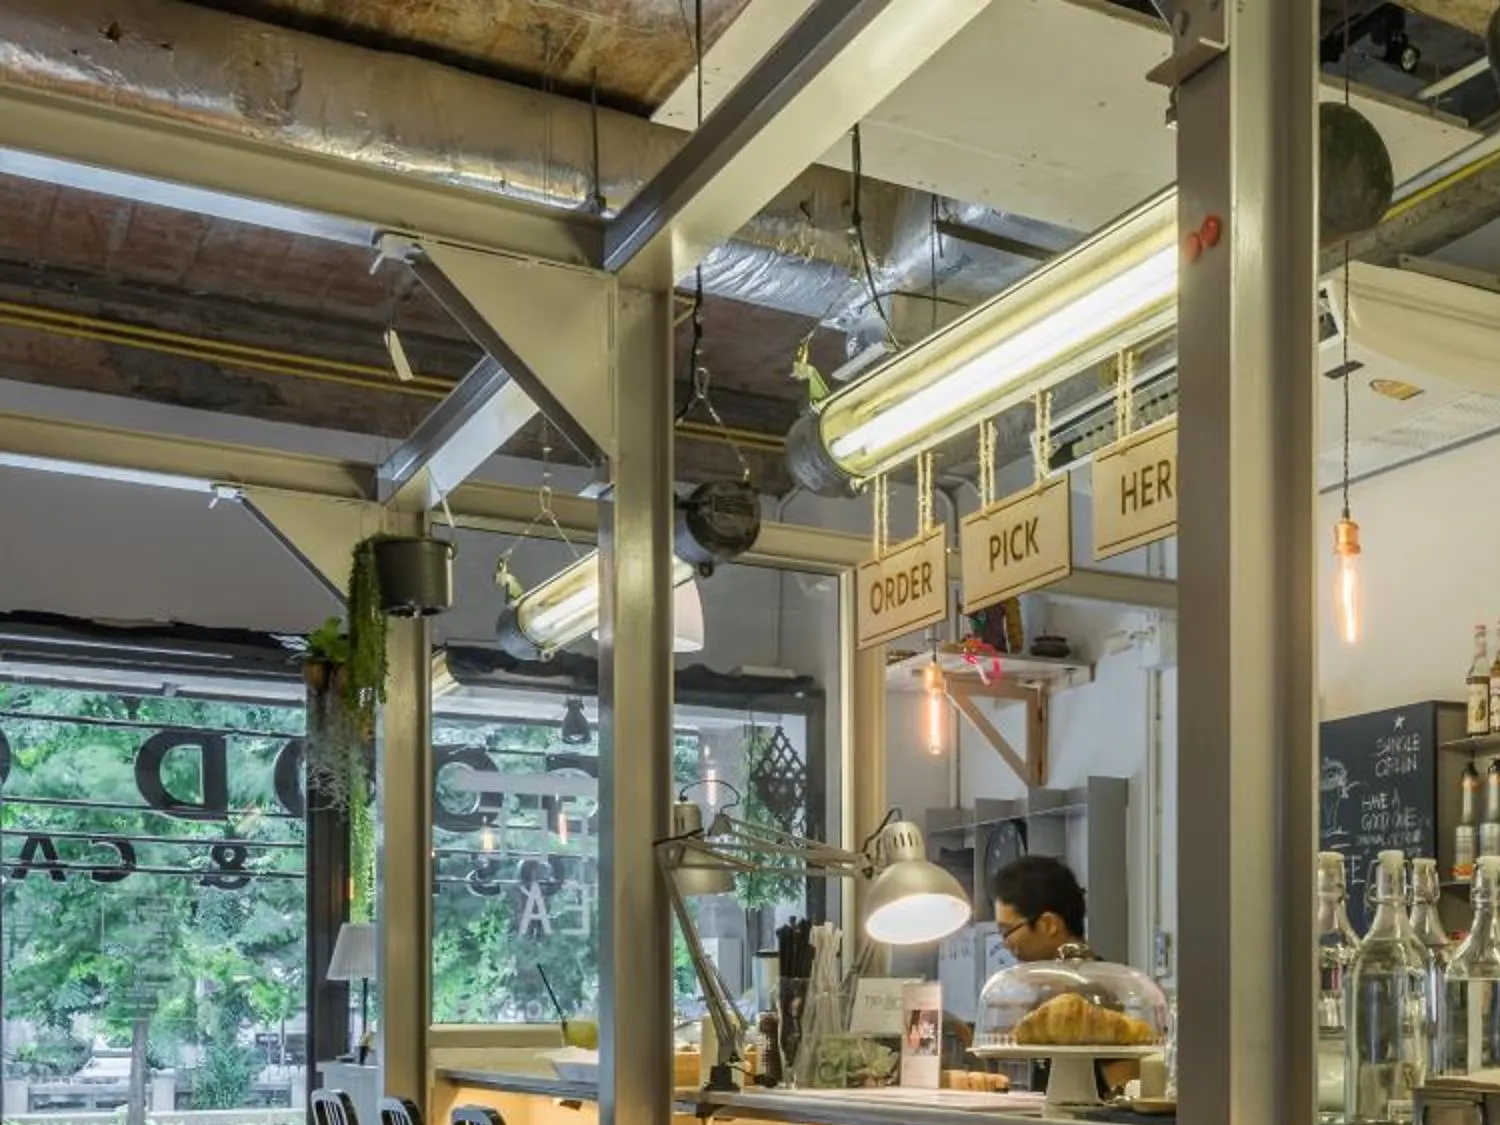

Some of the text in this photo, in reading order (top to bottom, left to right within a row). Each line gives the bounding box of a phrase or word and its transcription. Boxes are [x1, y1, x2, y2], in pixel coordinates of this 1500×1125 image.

[1120, 459, 1177, 515] HER
[988, 517, 1040, 572] PICK
[869, 561, 934, 616] ORDER
